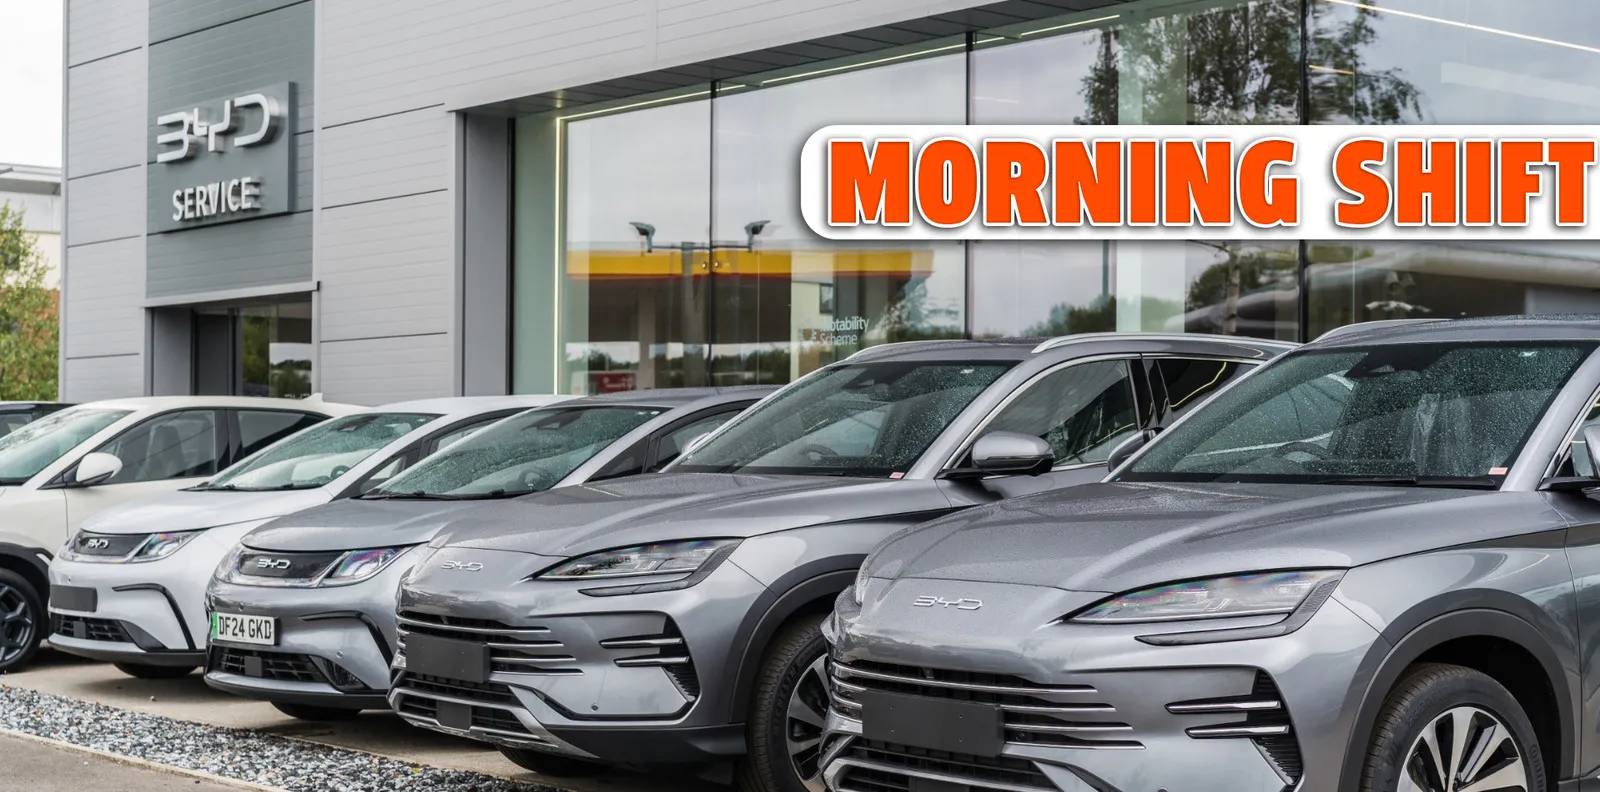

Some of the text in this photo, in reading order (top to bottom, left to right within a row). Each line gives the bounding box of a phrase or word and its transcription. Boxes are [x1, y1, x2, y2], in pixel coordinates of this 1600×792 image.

[157, 93, 271, 163] BYD
[172, 177, 252, 221] SERVICE
[820, 315, 869, 332] otability
[820, 332, 858, 346] Scheme
[87, 539, 109, 549] BYD
[258, 558, 291, 569] BYD
[441, 560, 483, 571] BYD
[913, 595, 983, 610] BYD
[218, 616, 272, 639] DF24 GKD
